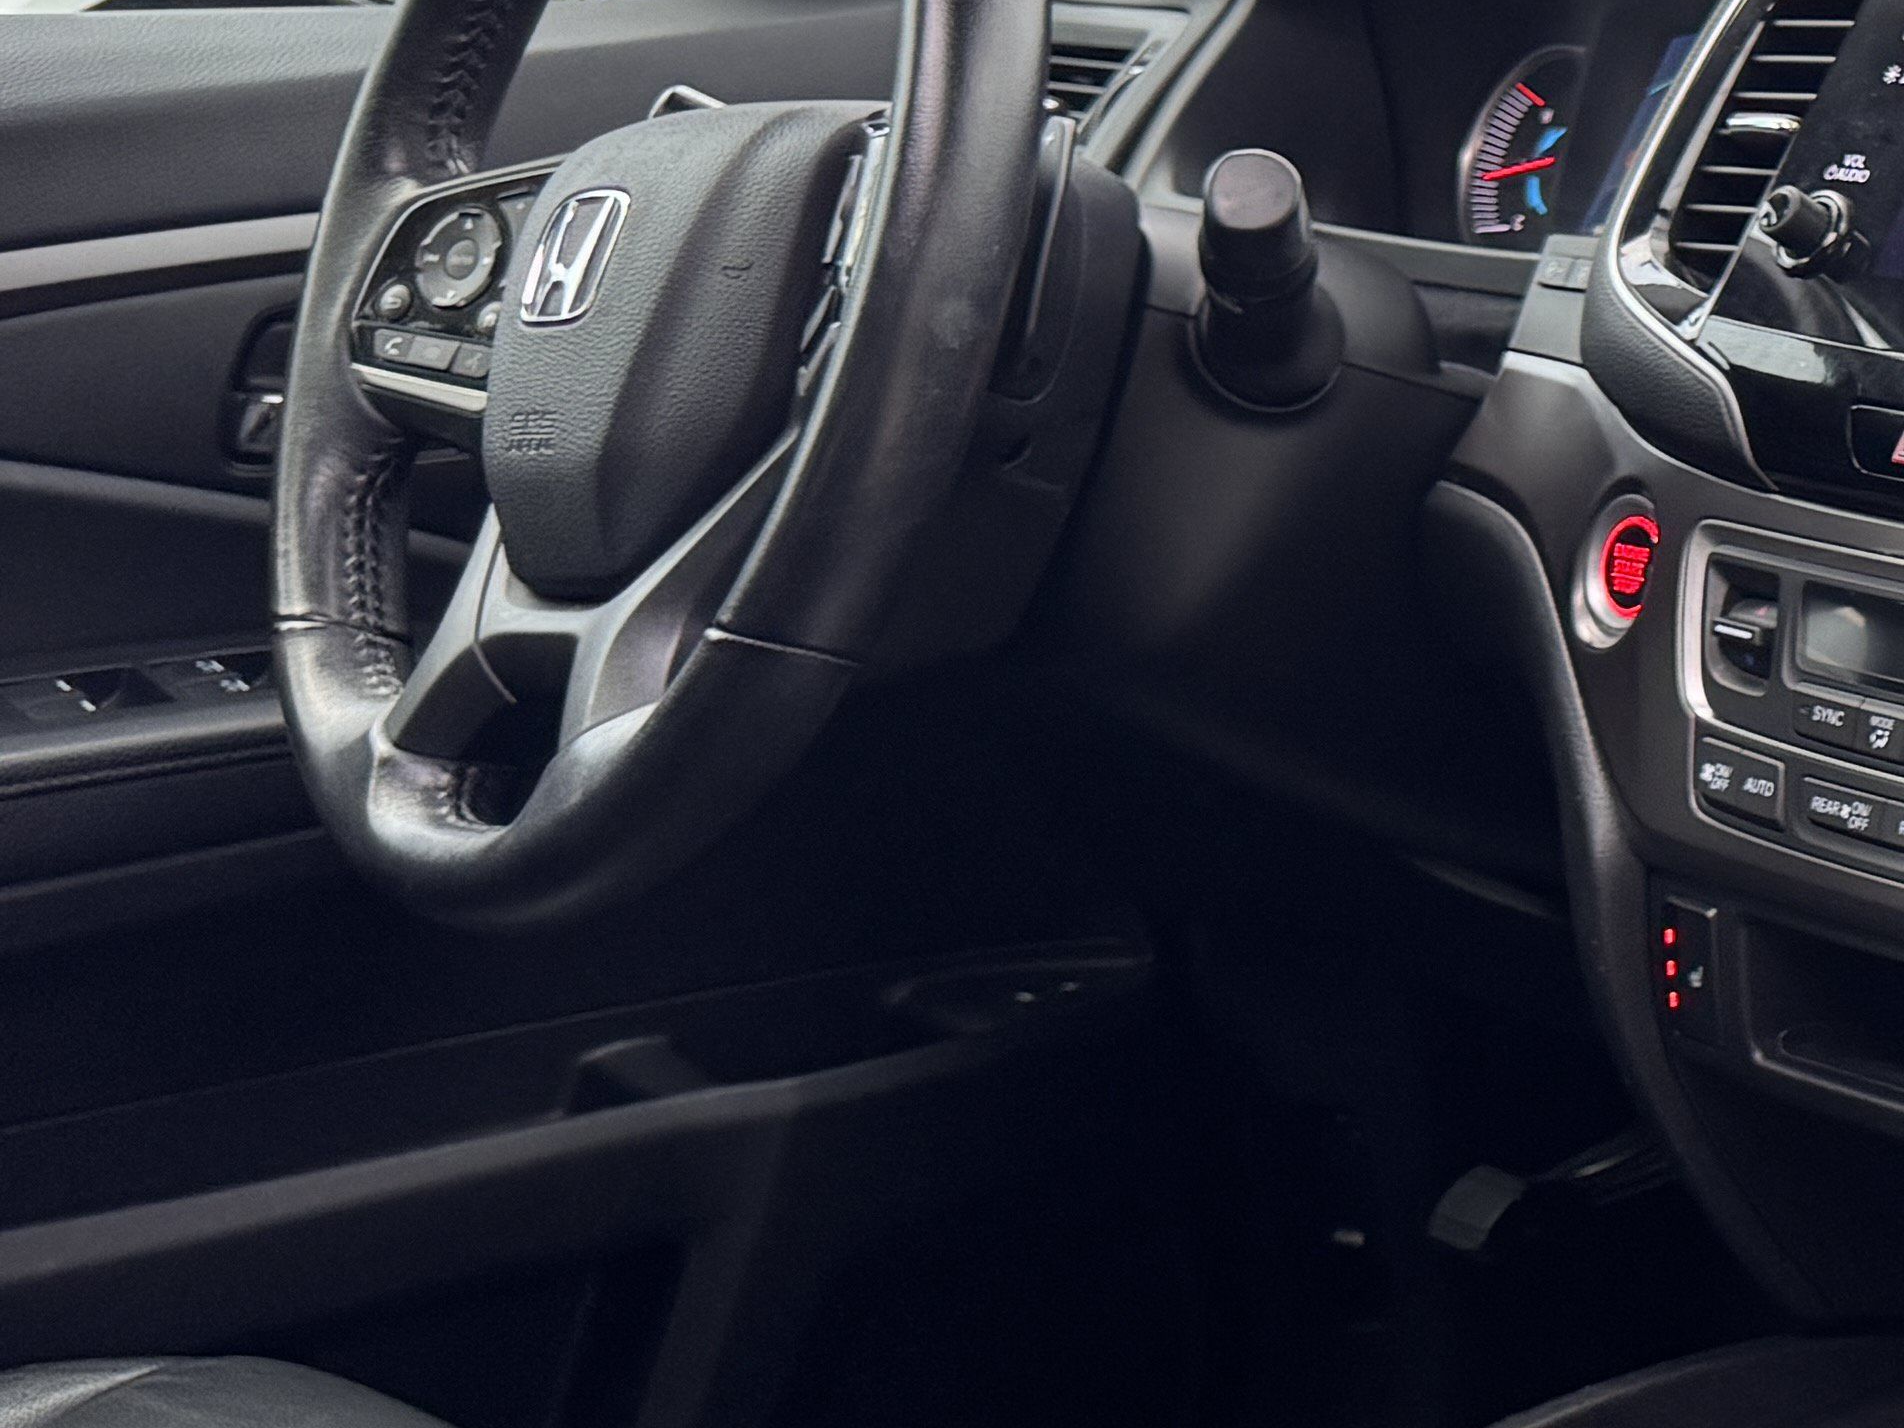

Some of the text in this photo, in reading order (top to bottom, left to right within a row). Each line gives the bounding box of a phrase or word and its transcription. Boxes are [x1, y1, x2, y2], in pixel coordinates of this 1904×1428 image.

[1812, 705, 1846, 727] SYNC
[1742, 777, 1775, 797] AUTO
[1810, 795, 1842, 817] REAR
